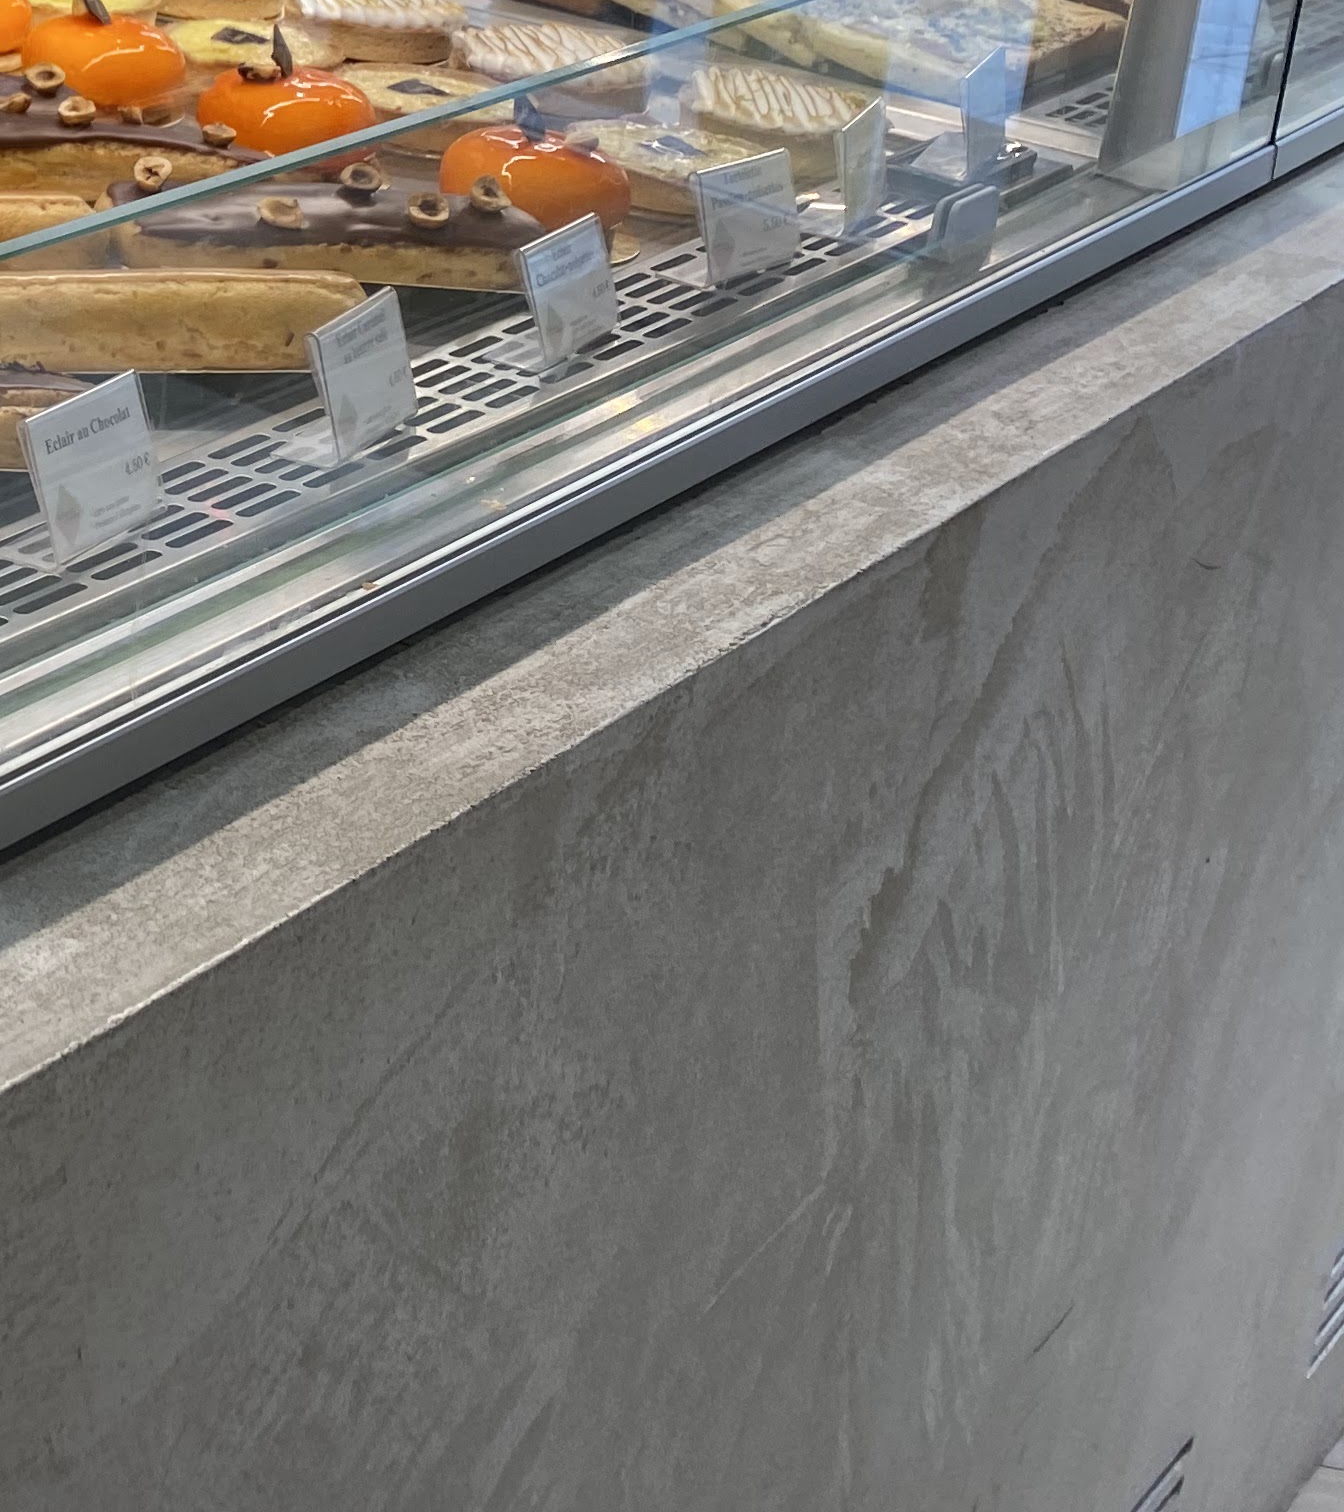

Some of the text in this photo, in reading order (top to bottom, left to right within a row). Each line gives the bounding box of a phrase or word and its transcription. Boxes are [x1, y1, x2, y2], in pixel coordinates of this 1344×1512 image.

[44, 405, 131, 456] Eclair au Chocolat
